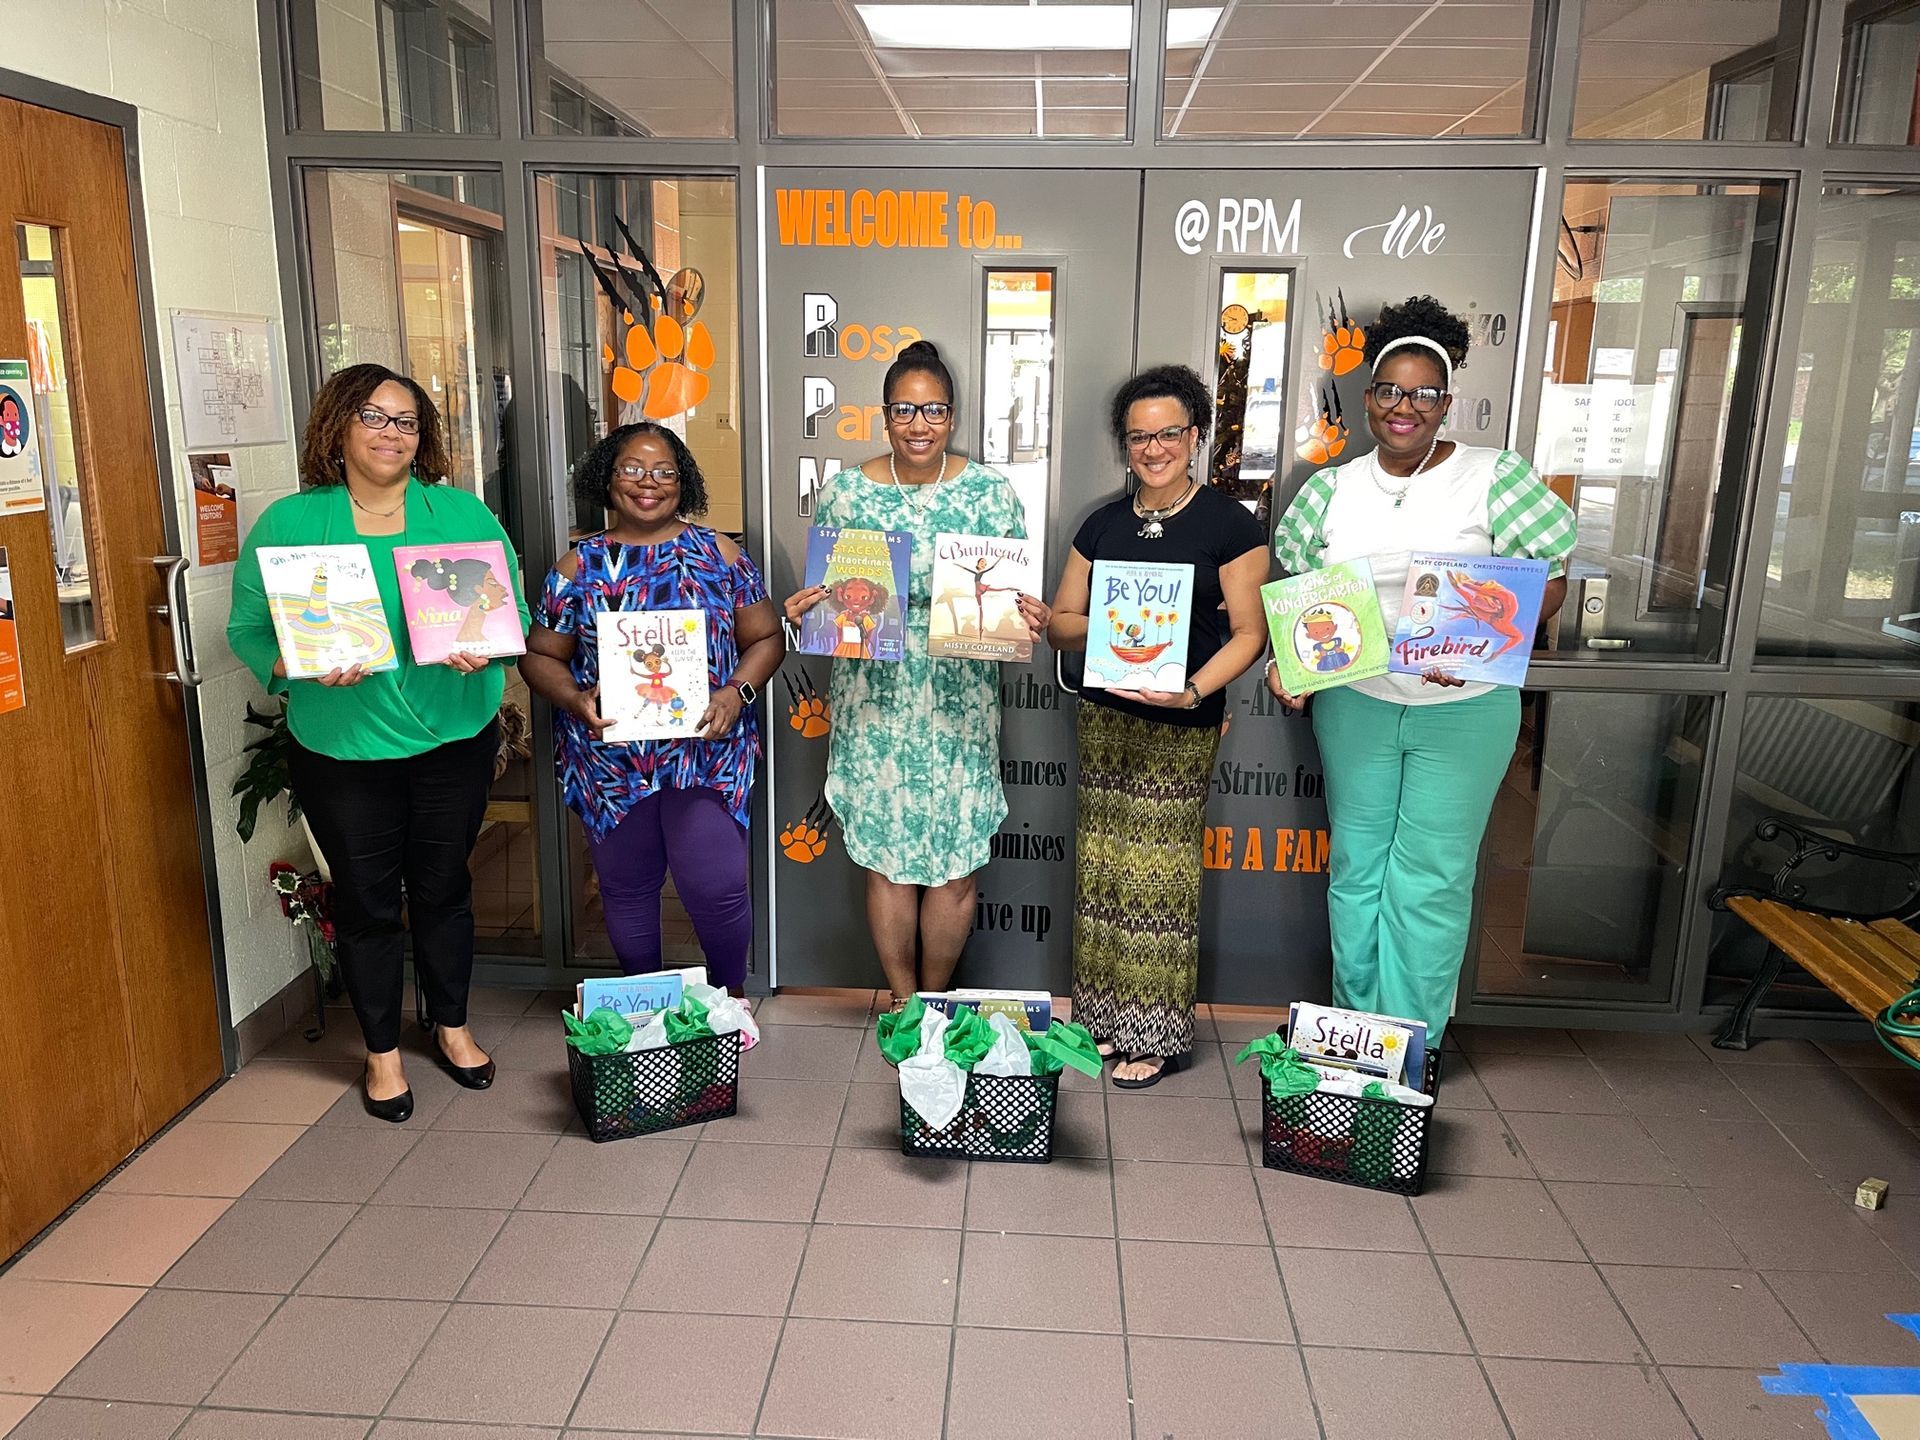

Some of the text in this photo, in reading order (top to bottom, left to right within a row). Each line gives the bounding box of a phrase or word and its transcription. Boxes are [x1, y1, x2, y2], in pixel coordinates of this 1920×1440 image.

[776, 189, 948, 247] WELCOME
[1343, 204, 1446, 259] We
[803, 376, 890, 441] Par
[1574, 398, 1591, 406] SAF
[200, 503, 225, 513] WELCOME
[200, 511, 223, 520] VISITORS
[820, 530, 902, 544] STACEY ABRAMS
[832, 543, 891, 557] STACEY'S
[826, 554, 893, 570] Extraordinary
[939, 541, 1030, 567] Bunheads
[1433, 561, 1468, 569] COPELAND
[1473, 563, 1519, 572] CHRISTOPHER
[835, 566, 883, 577] WORDS
[1104, 576, 1130, 606] Be
[411, 606, 462, 626] Nina
[616, 617, 688, 648] Stella
[943, 641, 969, 650] MISTY
[971, 643, 1015, 654] COPELAND
[1396, 626, 1489, 666] Firebird
[1000, 759, 1067, 787] ances
[990, 822, 1065, 862] omises
[1241, 827, 1264, 871] A
[1273, 828, 1331, 873] FAM
[969, 892, 1051, 942] ive up
[1000, 1004, 1041, 1013] ABRAMS
[1312, 1016, 1385, 1060] Stella
